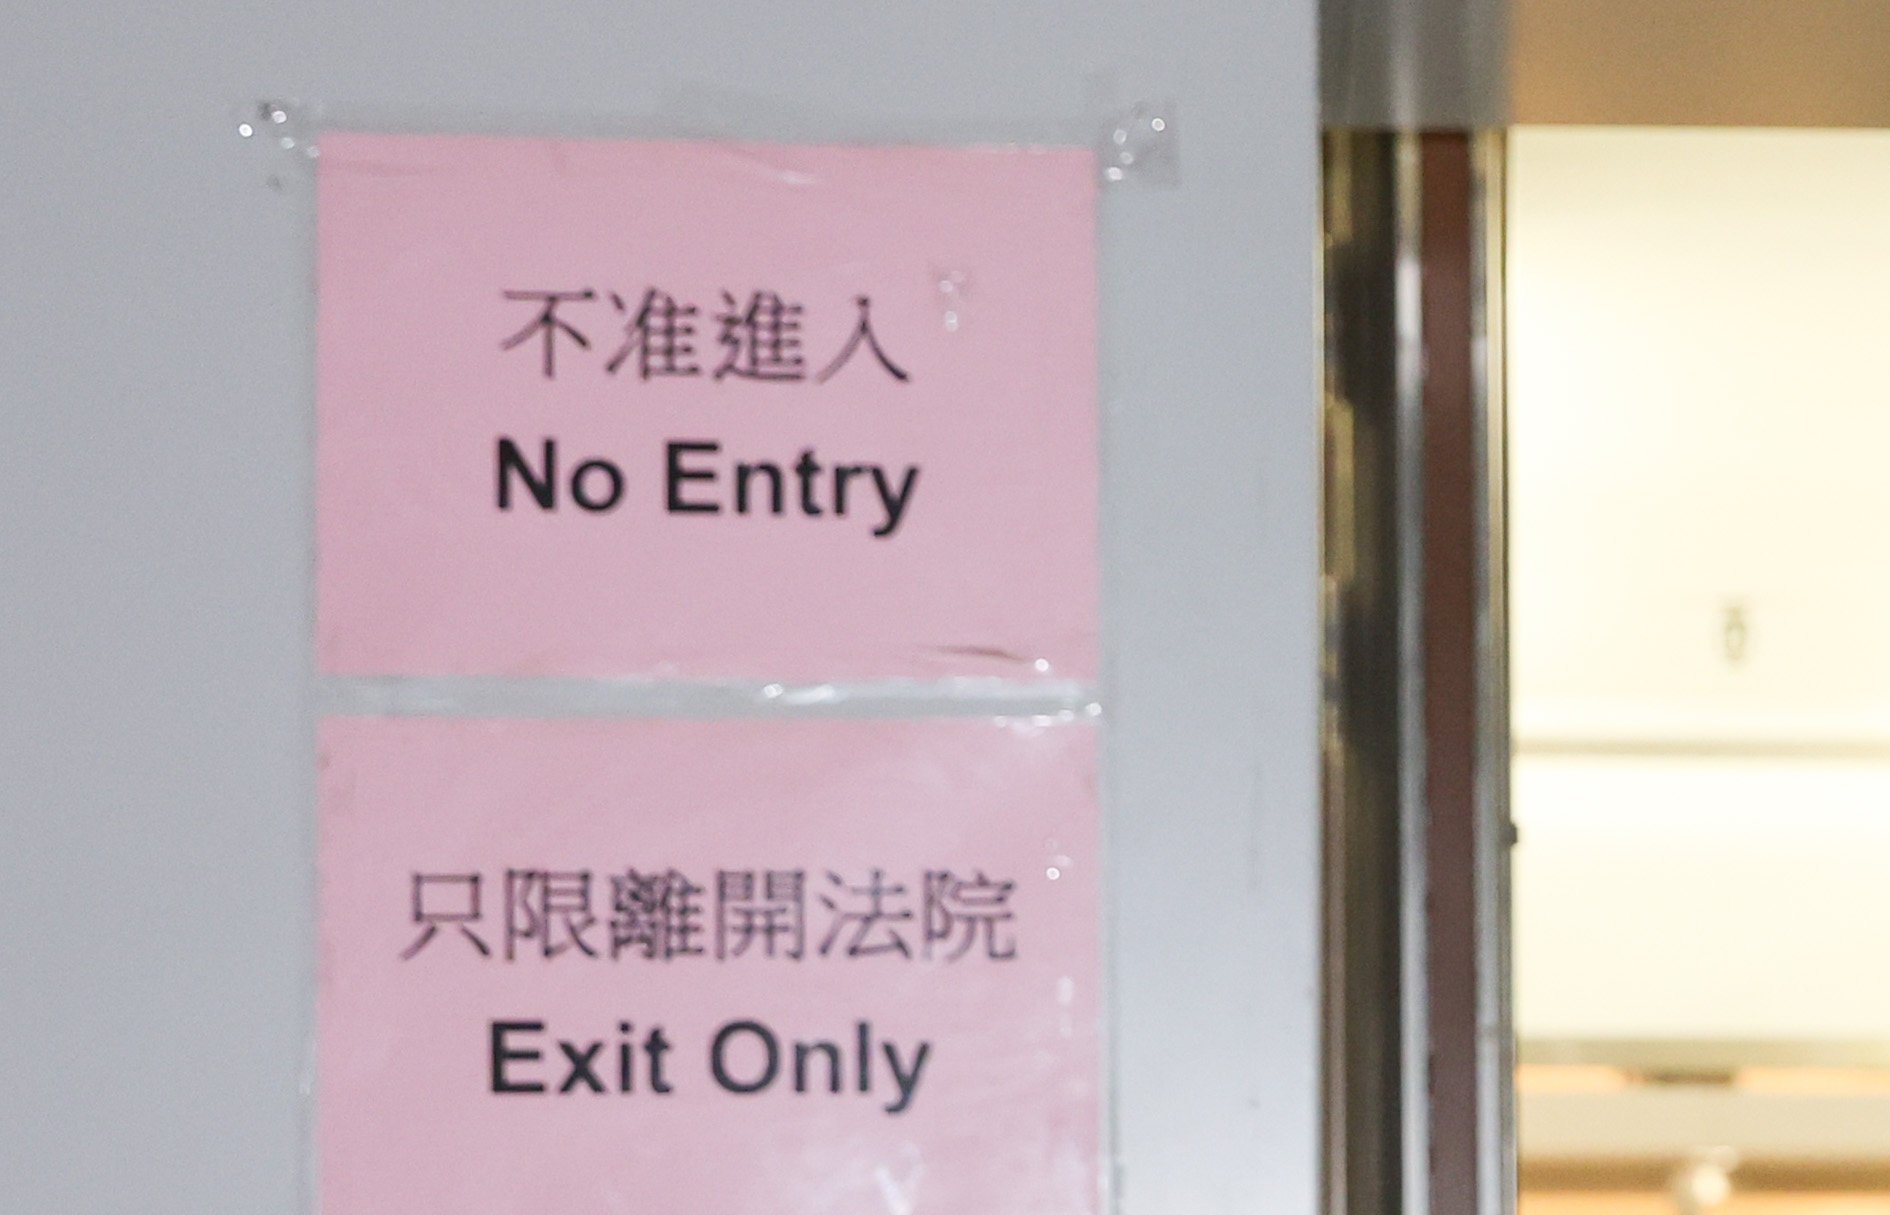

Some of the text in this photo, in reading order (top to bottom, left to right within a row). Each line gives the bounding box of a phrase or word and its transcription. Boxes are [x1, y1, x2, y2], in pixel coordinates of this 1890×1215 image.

[500, 284, 913, 387] 不准進入
[493, 434, 923, 540] No Entry
[398, 865, 1021, 965] 只限離開法院
[486, 1017, 933, 1117] Exit Only
